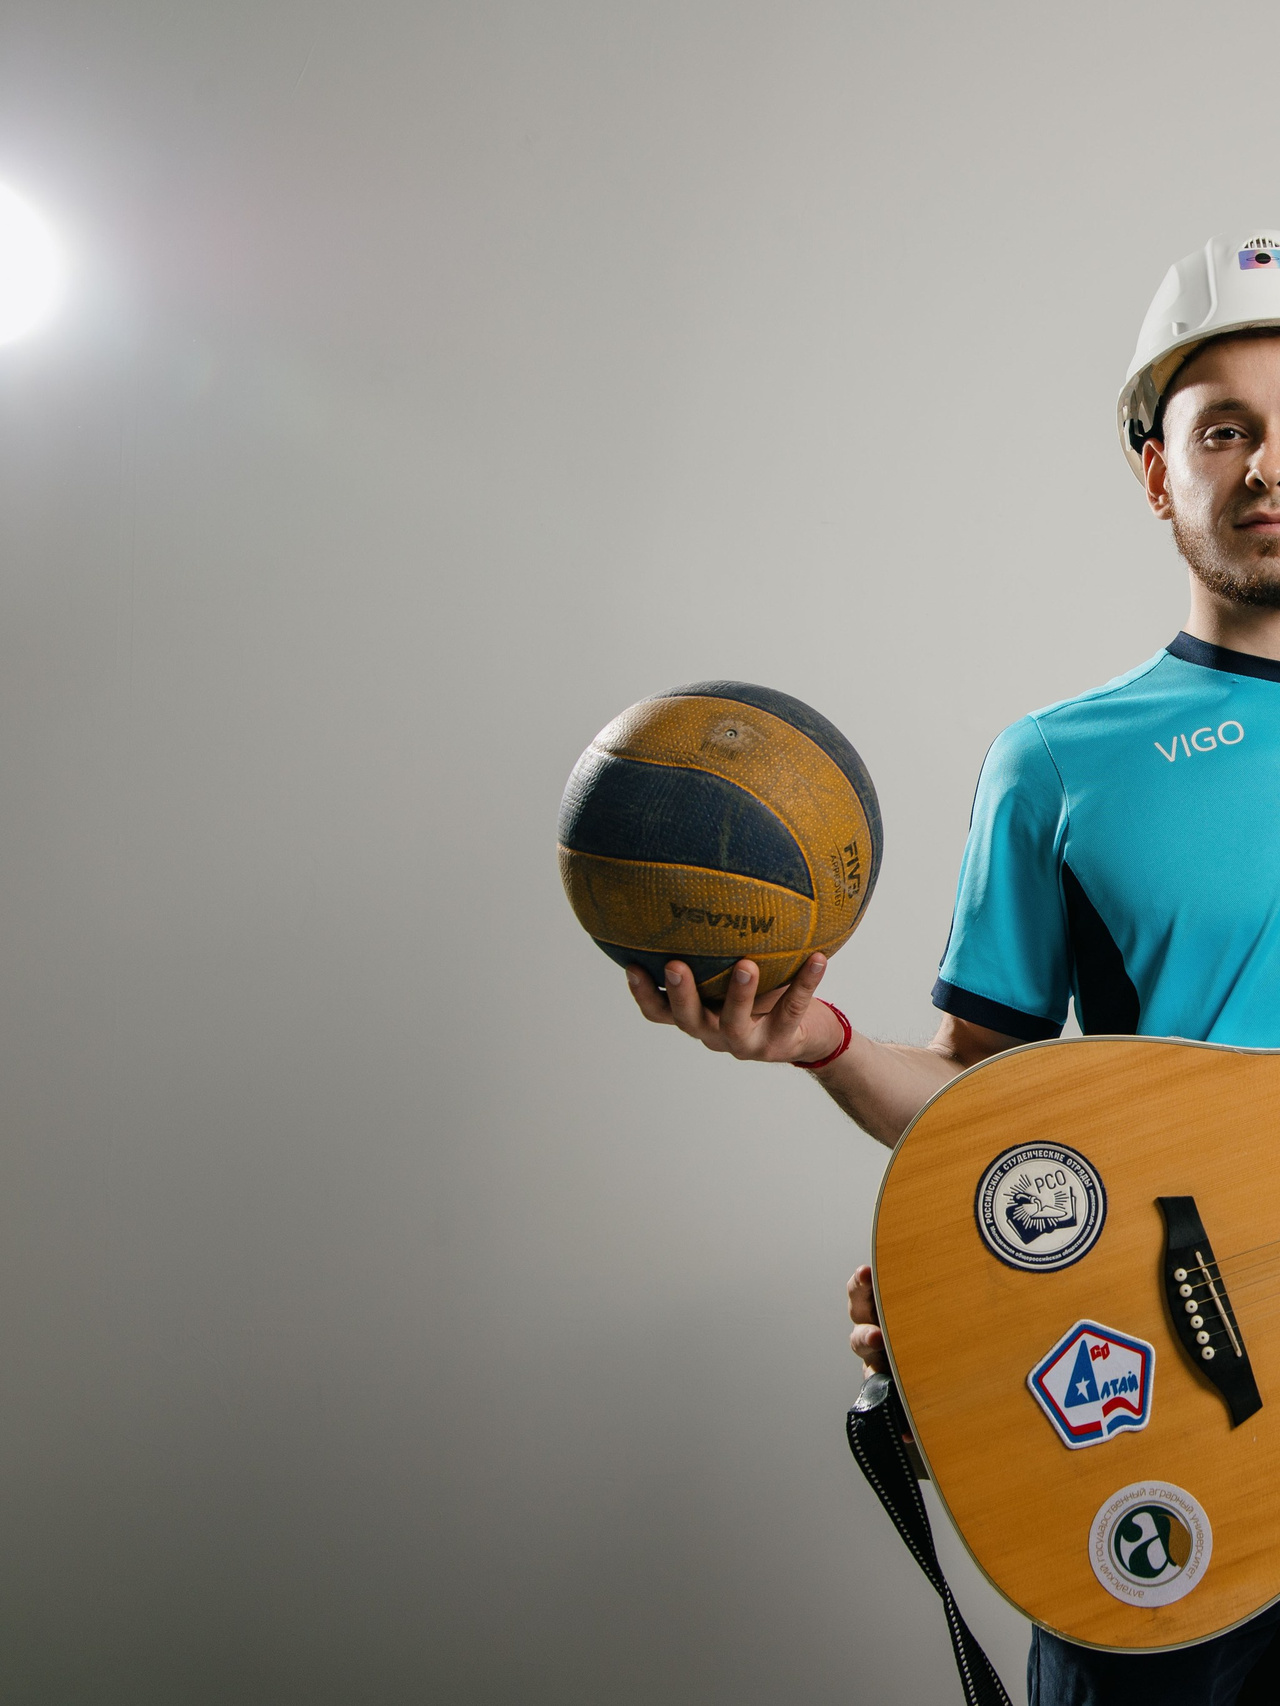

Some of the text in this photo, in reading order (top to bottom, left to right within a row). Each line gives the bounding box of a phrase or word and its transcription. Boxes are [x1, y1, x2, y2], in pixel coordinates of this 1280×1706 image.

[1153, 720, 1245, 763] VIGO
[829, 854, 842, 907] APPROVED
[983, 1149, 1093, 1224] РОССИЙСКИЕ СТУДЕНЧЕСКИЕ ОТРЯДЫ
[1033, 1169, 1067, 1194] РСО
[1095, 1486, 1205, 1599] алтайский государственный аграрный университет
